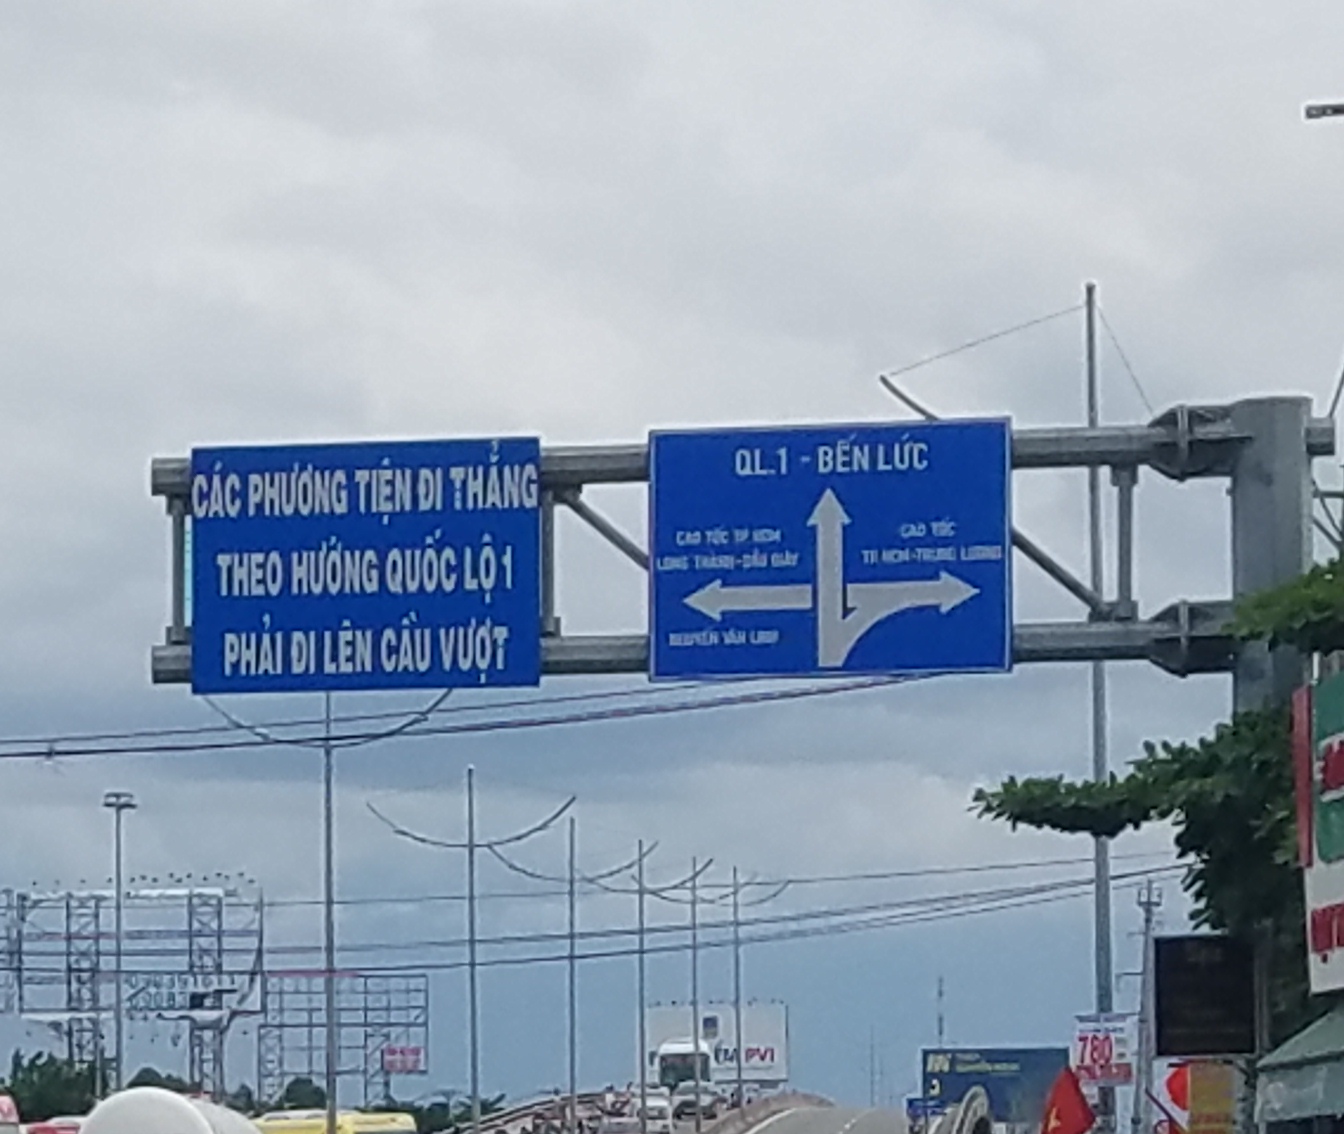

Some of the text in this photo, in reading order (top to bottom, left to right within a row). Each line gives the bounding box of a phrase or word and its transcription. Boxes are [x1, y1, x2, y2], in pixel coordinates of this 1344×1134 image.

[192, 440, 538, 525] CÁC PHƯƠNG TIỆN ĐI THẲNG
[735, 448, 788, 476] QL.1
[818, 432, 870, 474] BẾN
[877, 434, 929, 471] LỨC
[217, 529, 512, 604] THEO HƯỚNG QUỐC LỘ 1
[224, 611, 509, 684] PHẢI ĐI LÊN CẦU VƯỢT
